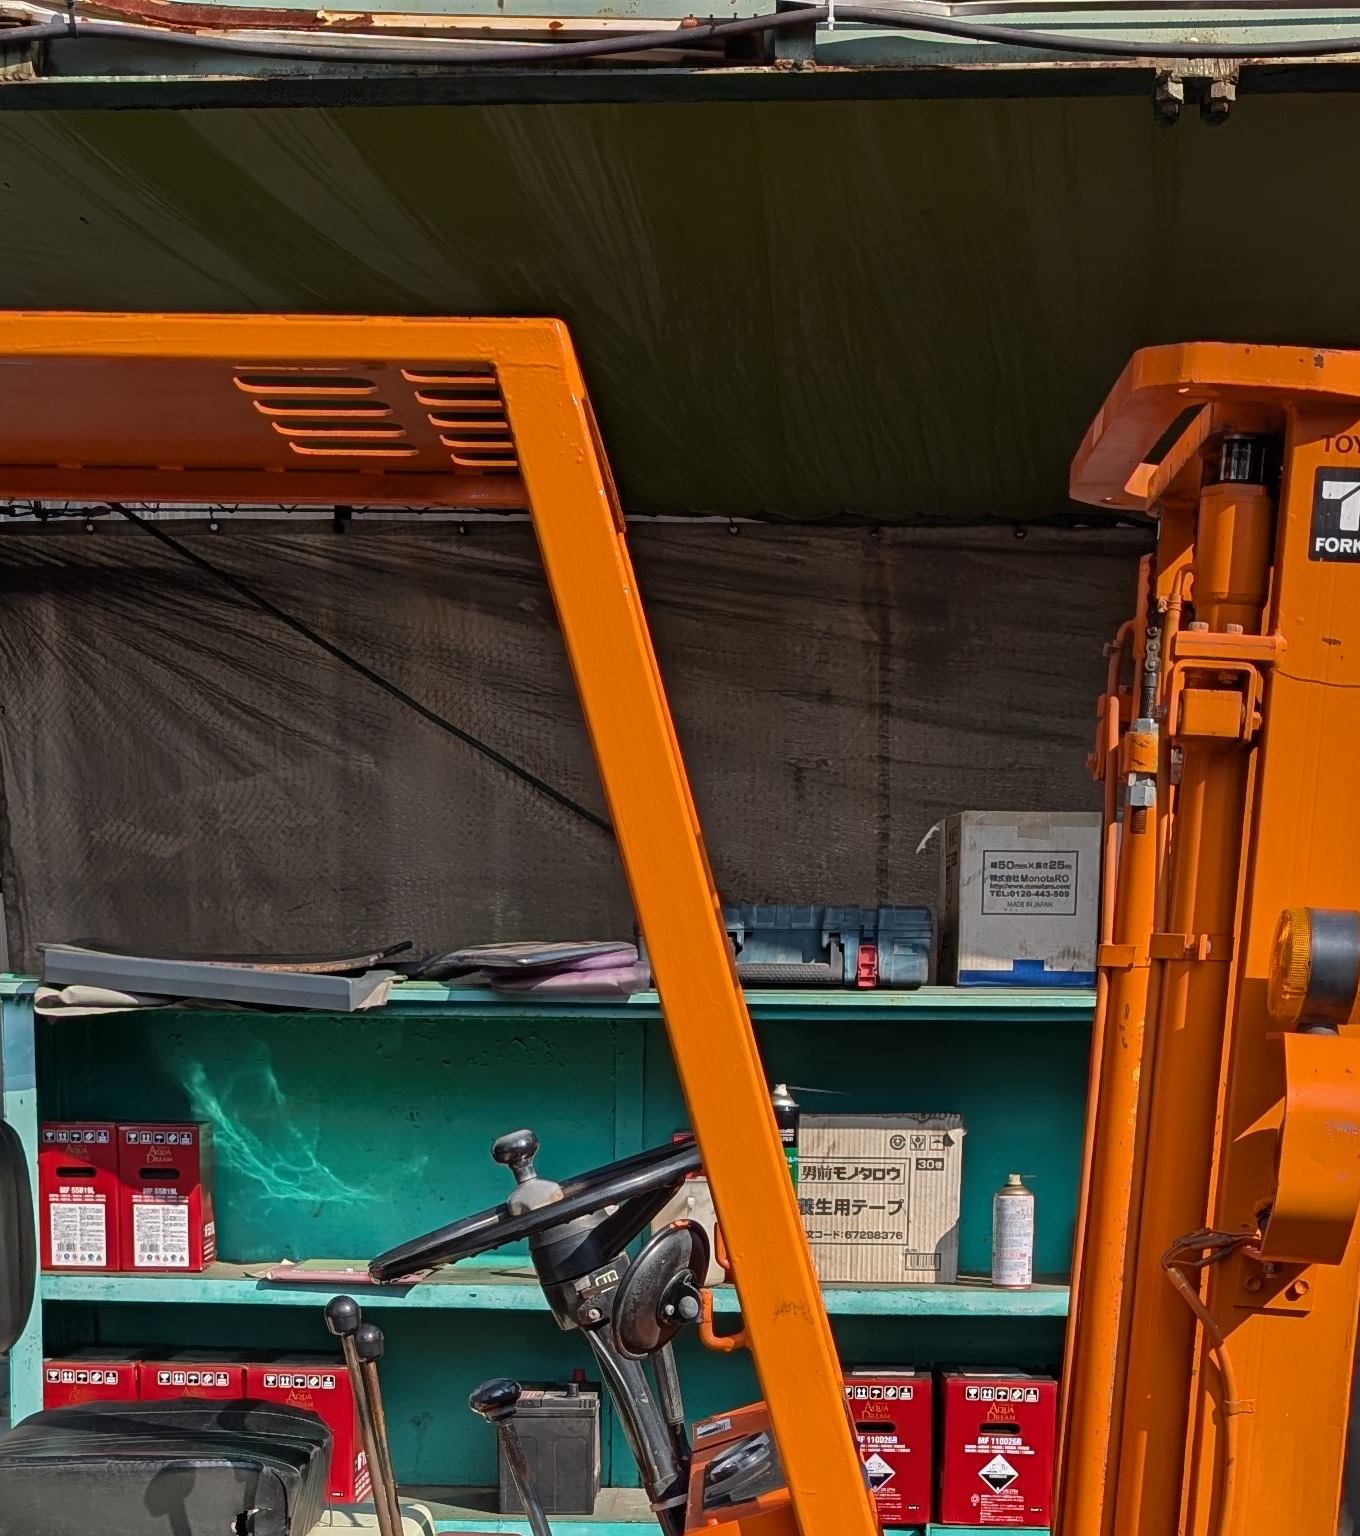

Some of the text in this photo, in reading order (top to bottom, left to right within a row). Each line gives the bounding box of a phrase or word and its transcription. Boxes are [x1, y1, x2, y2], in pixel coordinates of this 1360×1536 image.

[801, 1165, 901, 1182] 男前モノタロウ
